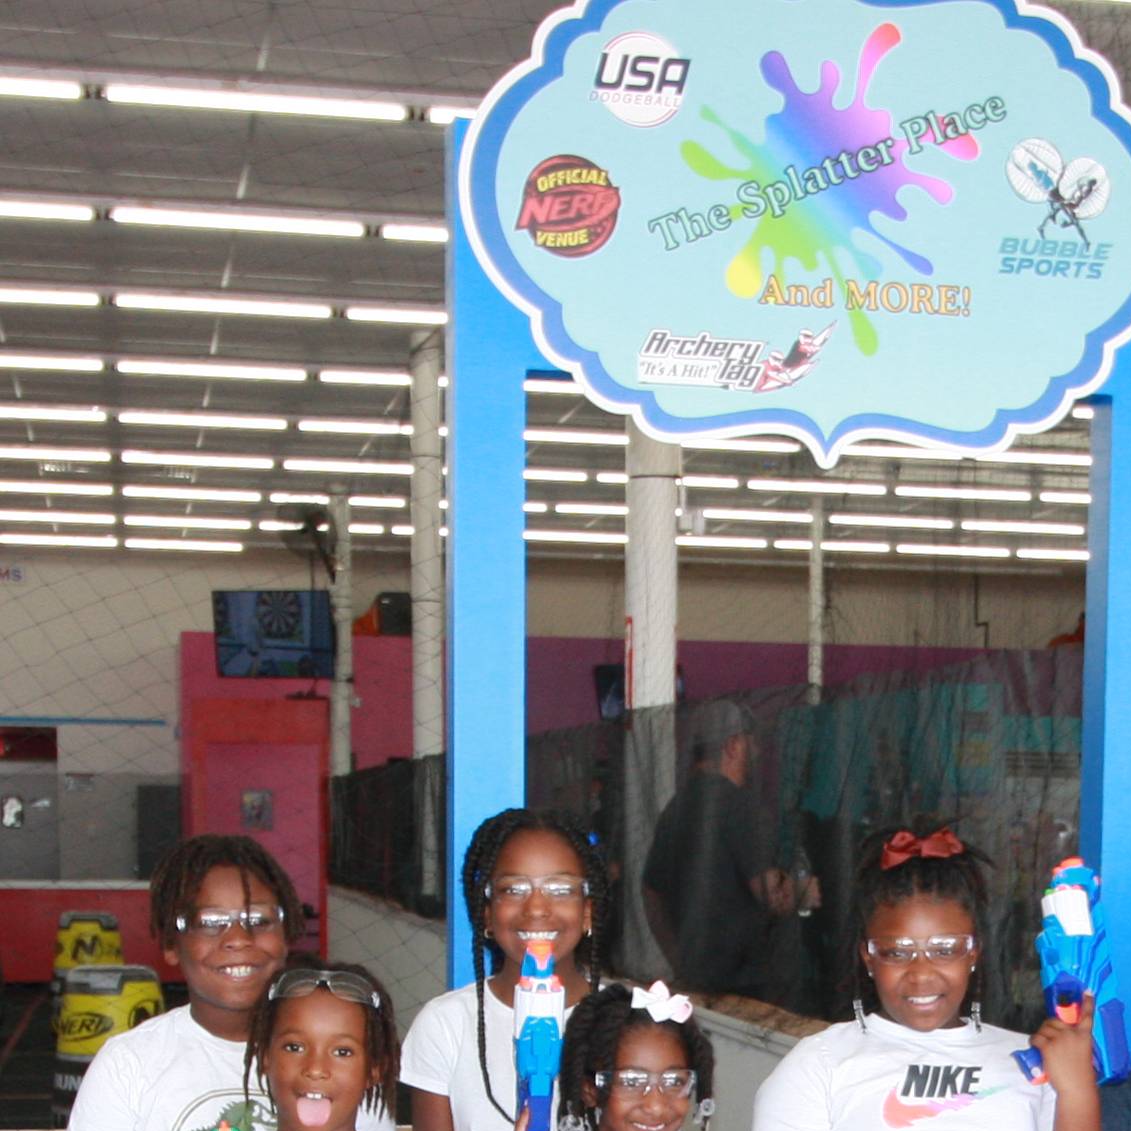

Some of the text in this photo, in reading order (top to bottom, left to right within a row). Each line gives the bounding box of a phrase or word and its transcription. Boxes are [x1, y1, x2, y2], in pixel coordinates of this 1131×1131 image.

[594, 52, 691, 95] USA
[589, 90, 681, 108] DODGEBALL
[536, 168, 608, 193] OFFICIAL
[648, 95, 1007, 251] The Splatter Place
[517, 189, 619, 229] NERF
[536, 228, 590, 247] VENUE
[998, 237, 1113, 260] BUBBLE
[998, 256, 1104, 279] SPORTS
[758, 274, 972, 316] And MORE!
[643, 331, 762, 366] Archery
[667, 364, 678, 377] A
[718, 358, 762, 388] Tag
[900, 1063, 982, 1099] NIKE
